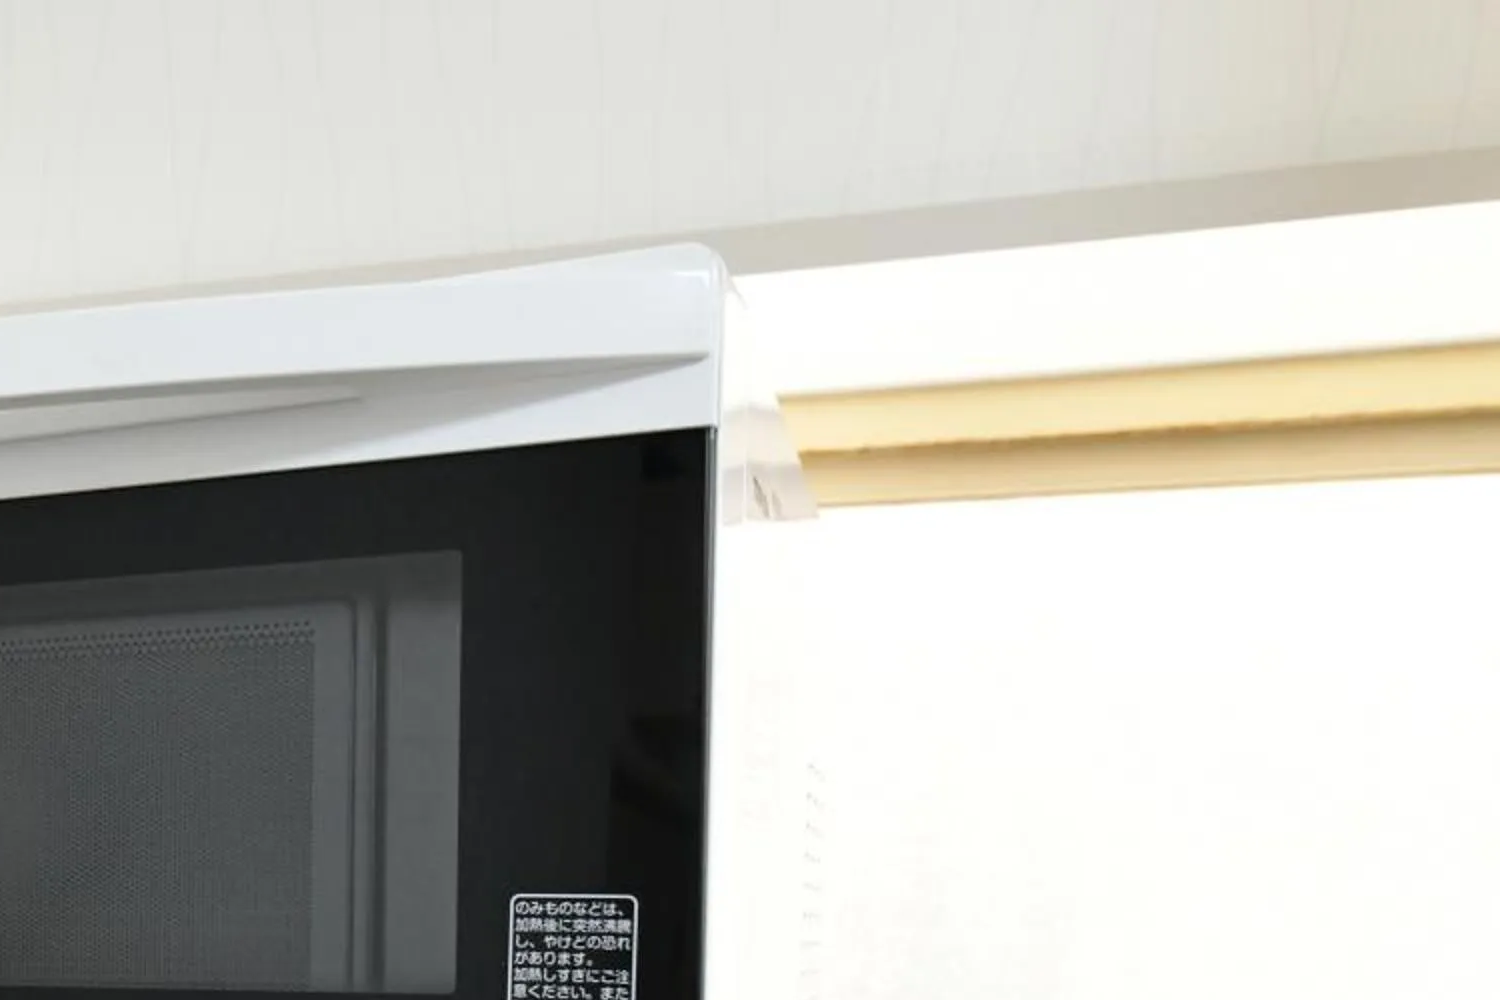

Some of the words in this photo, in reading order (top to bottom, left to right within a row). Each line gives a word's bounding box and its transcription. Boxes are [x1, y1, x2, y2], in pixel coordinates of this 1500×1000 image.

[515, 901, 624, 916] のみものなどは、
[514, 951, 593, 967] があります。
